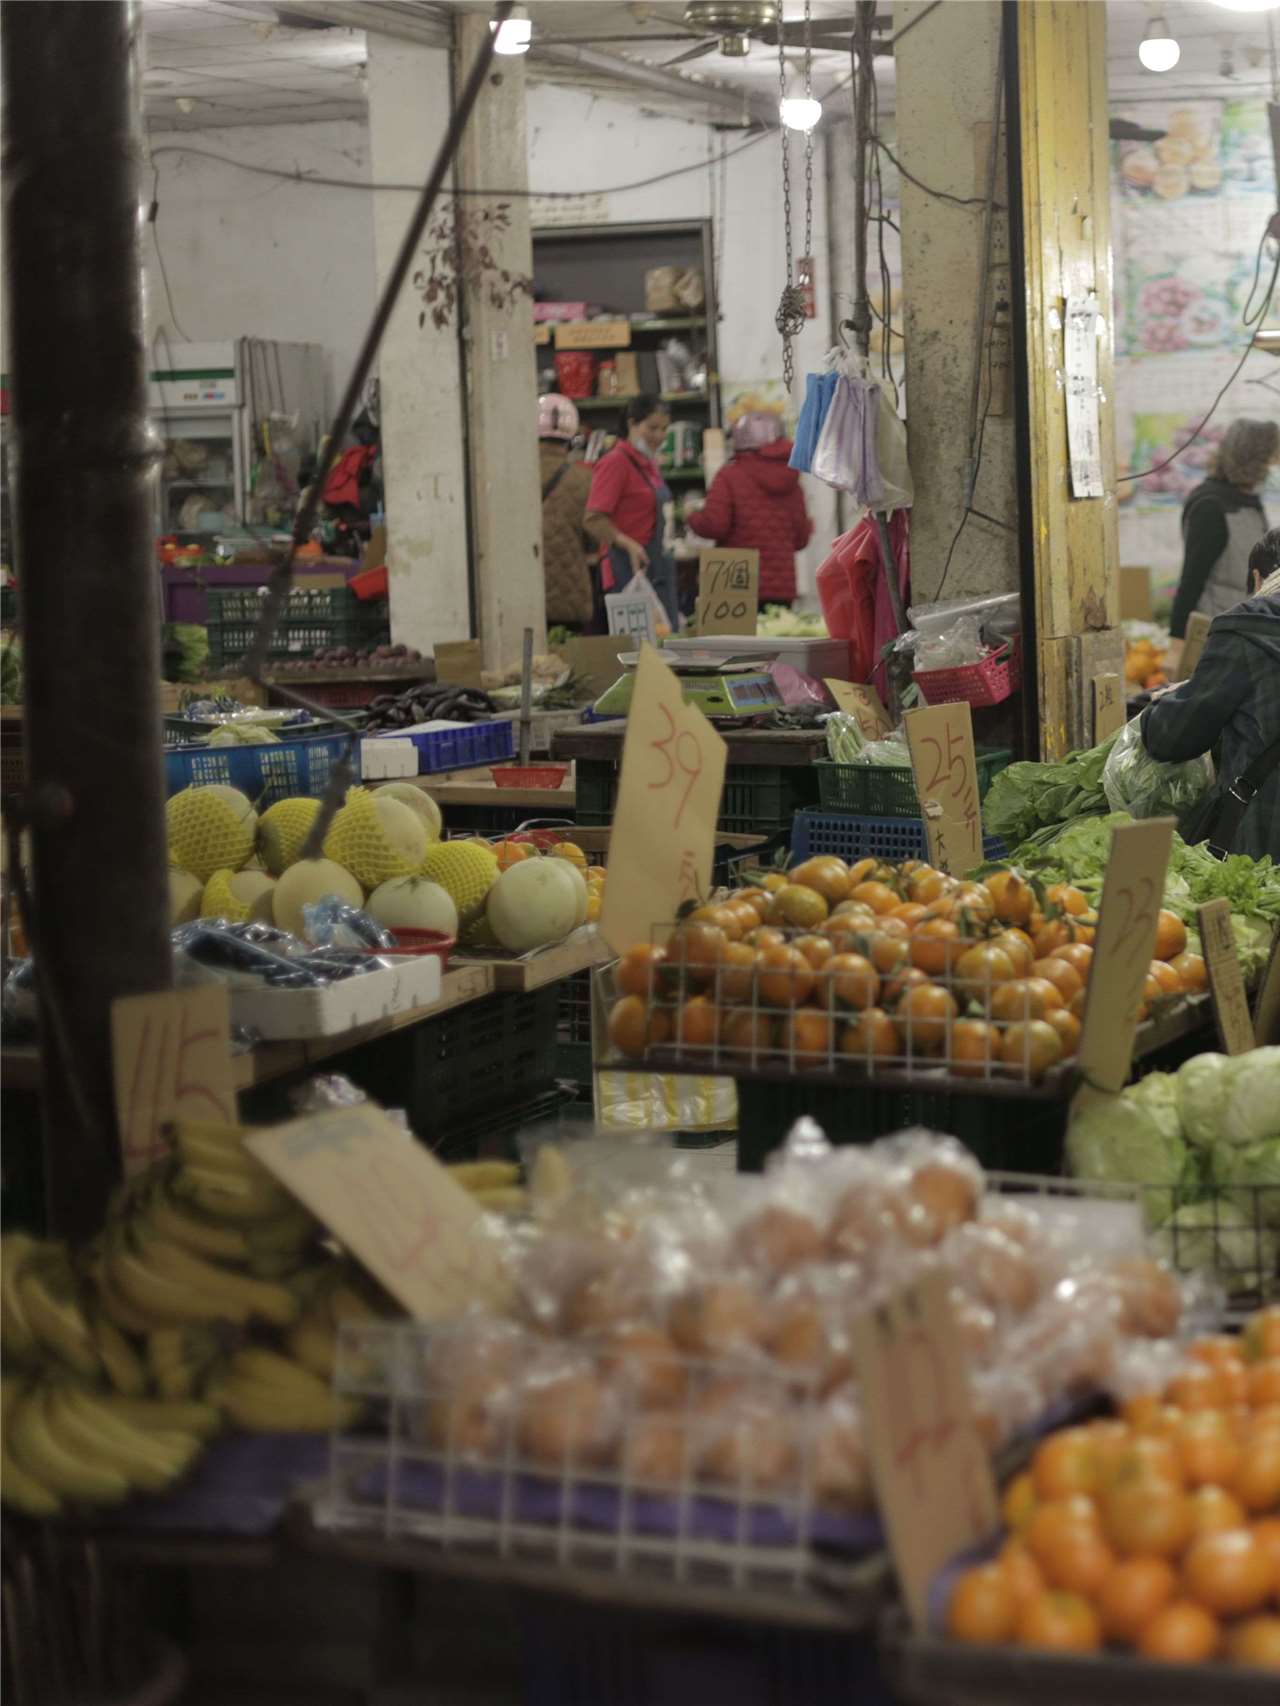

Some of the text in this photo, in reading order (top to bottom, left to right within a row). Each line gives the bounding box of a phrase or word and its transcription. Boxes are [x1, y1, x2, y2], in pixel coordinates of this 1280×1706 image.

[702, 600, 747, 626] 100
[647, 702, 703, 830] 39
[919, 721, 967, 798] 25
